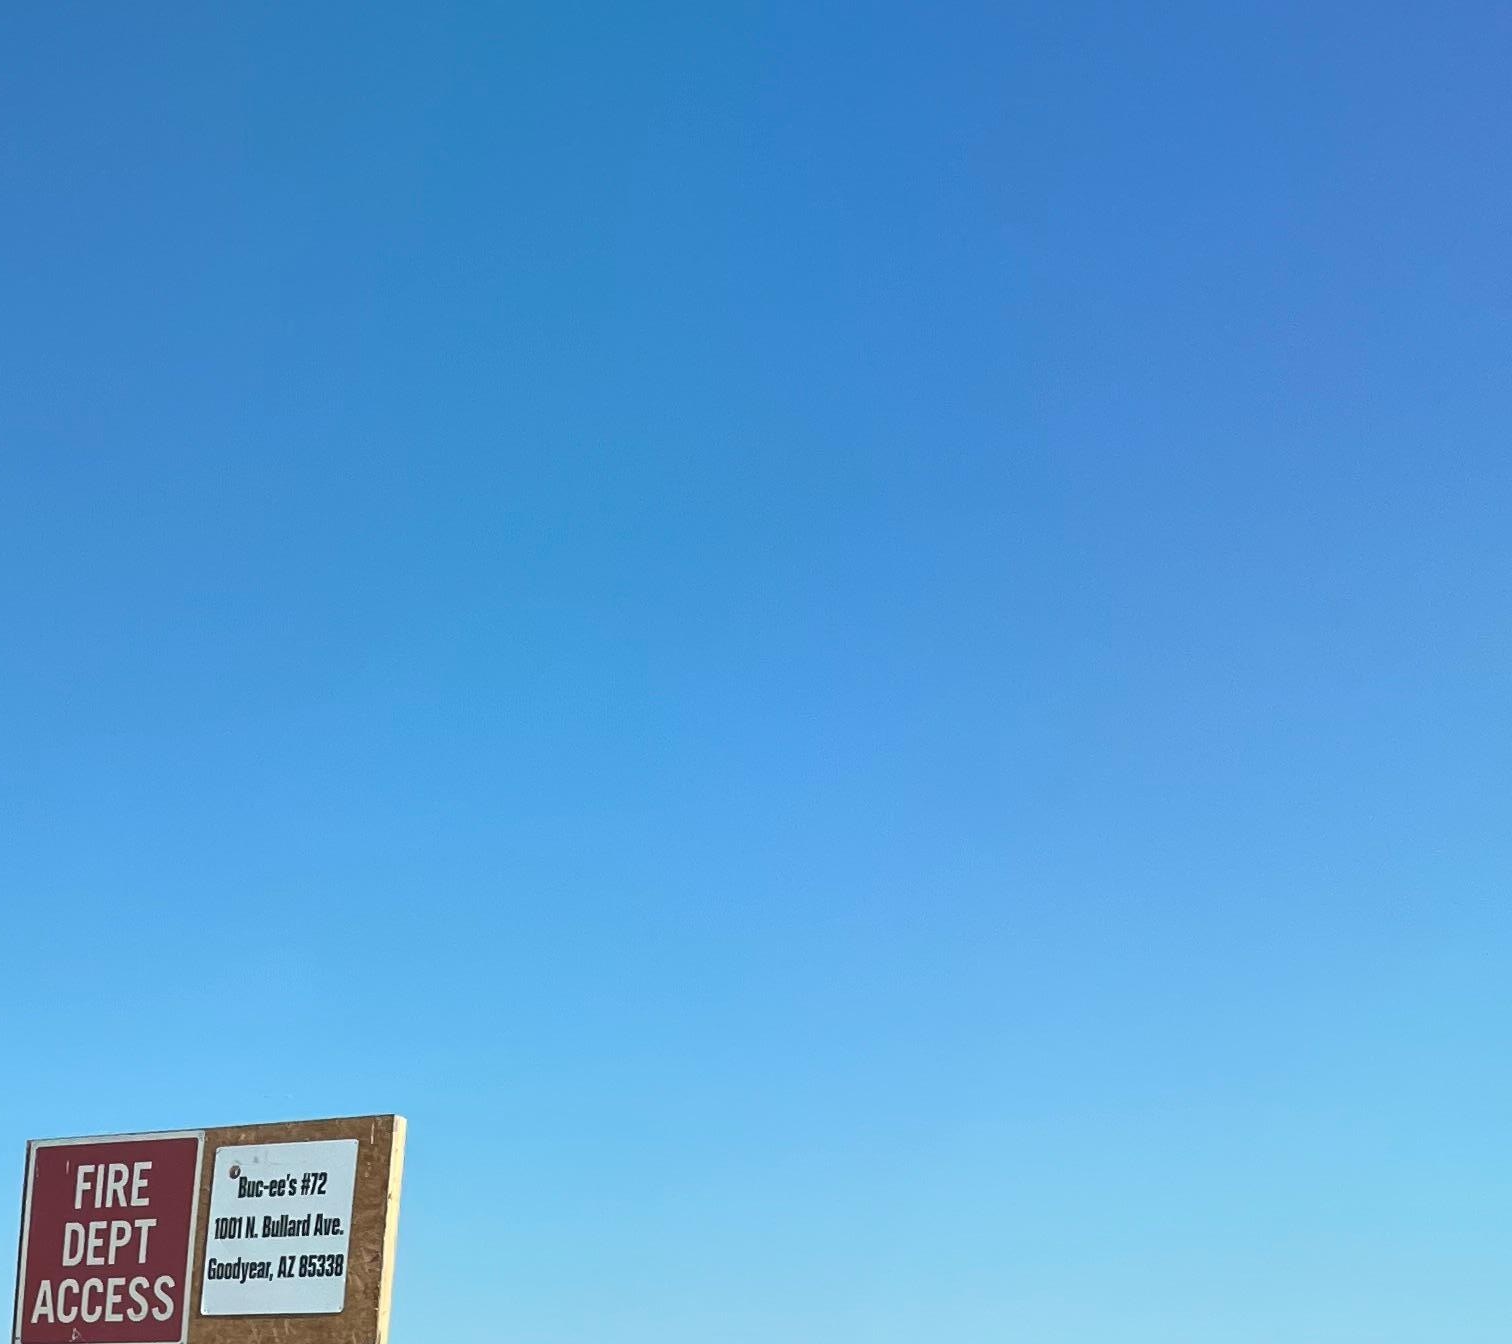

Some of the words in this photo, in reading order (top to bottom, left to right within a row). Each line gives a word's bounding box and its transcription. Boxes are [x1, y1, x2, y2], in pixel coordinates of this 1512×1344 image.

[74, 1161, 153, 1210] FIRE
[238, 1174, 297, 1198] Buc-ee's
[300, 1172, 328, 1196] #72
[62, 1218, 157, 1267] DEPT
[214, 1216, 243, 1240] 1001
[245, 1216, 258, 1239] N.
[261, 1213, 312, 1238] Bullard
[313, 1213, 344, 1237] Ave.
[207, 1257, 274, 1284] Goodyear,
[277, 1255, 296, 1279] AZ
[298, 1253, 345, 1278] 85338
[30, 1275, 176, 1324] ACCESS
